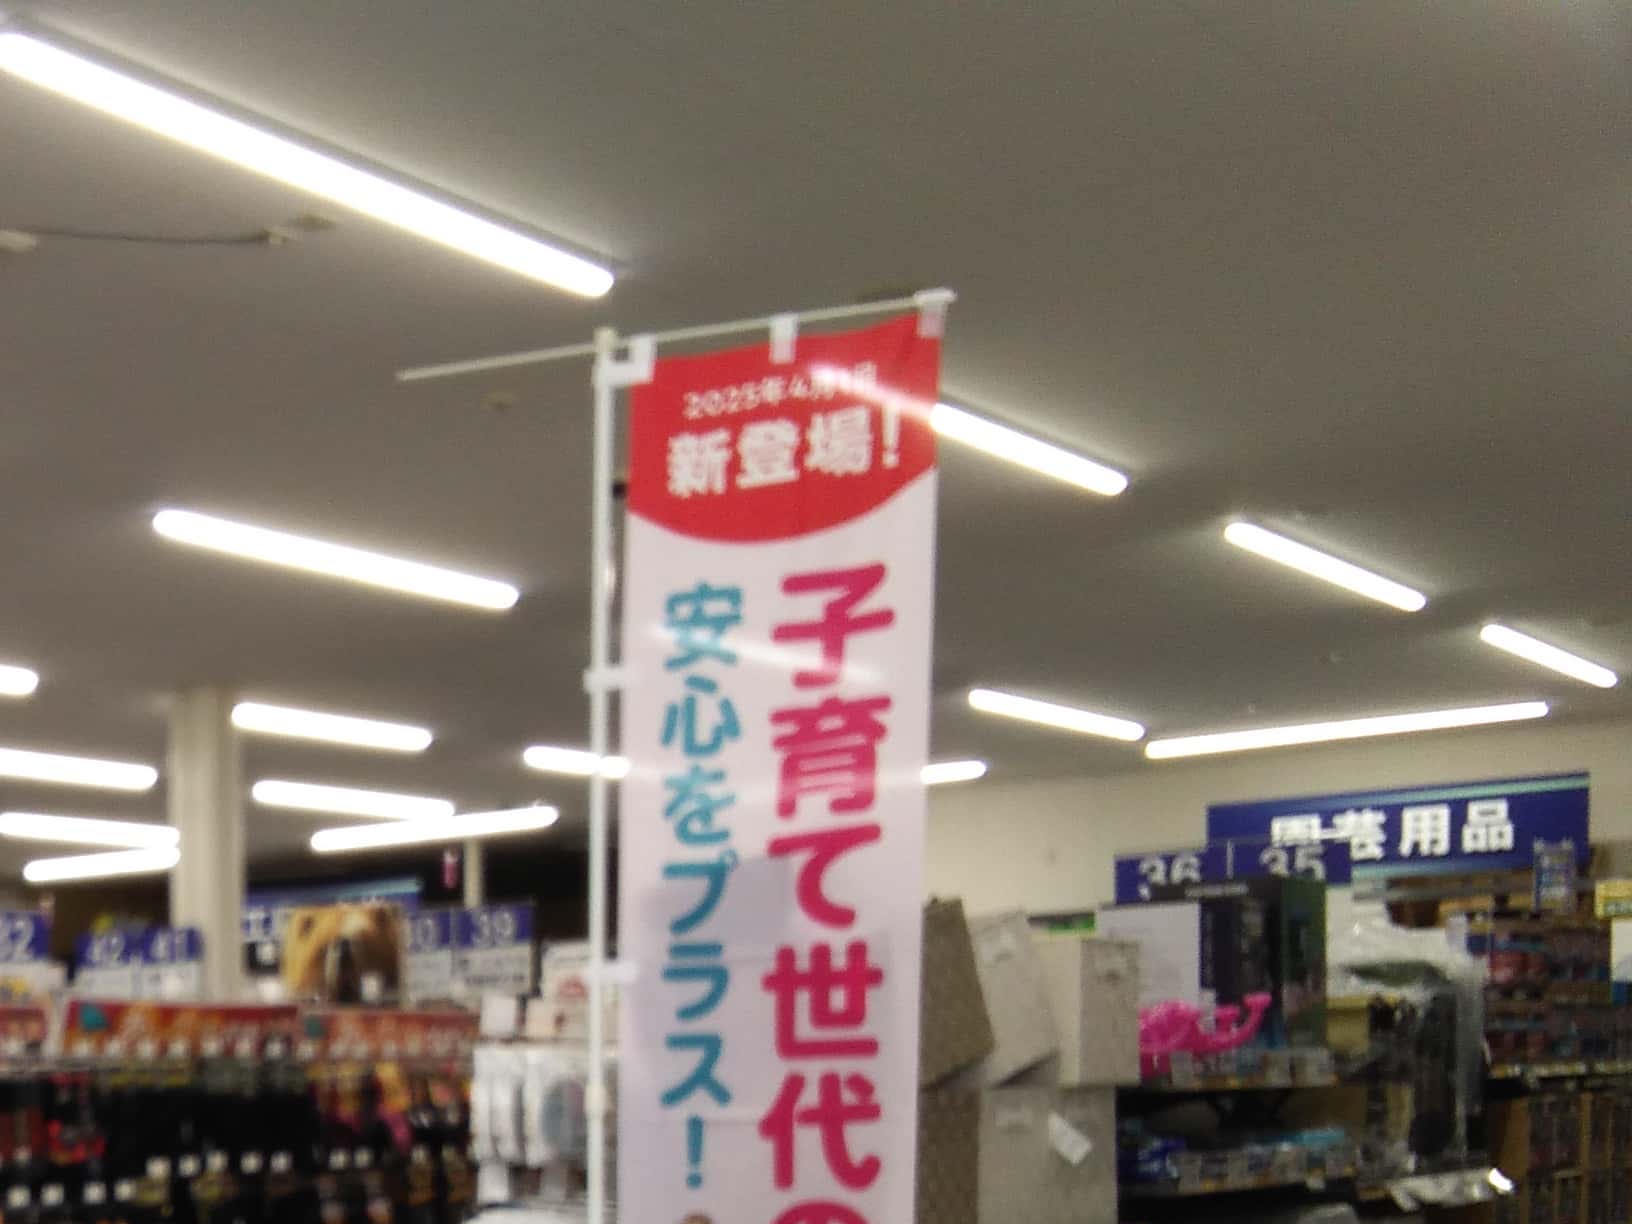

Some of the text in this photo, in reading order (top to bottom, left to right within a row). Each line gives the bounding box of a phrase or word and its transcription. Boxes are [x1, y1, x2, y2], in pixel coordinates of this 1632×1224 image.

[667, 402, 901, 500] 新登場!
[659, 580, 745, 1190] 安心をプラス!
